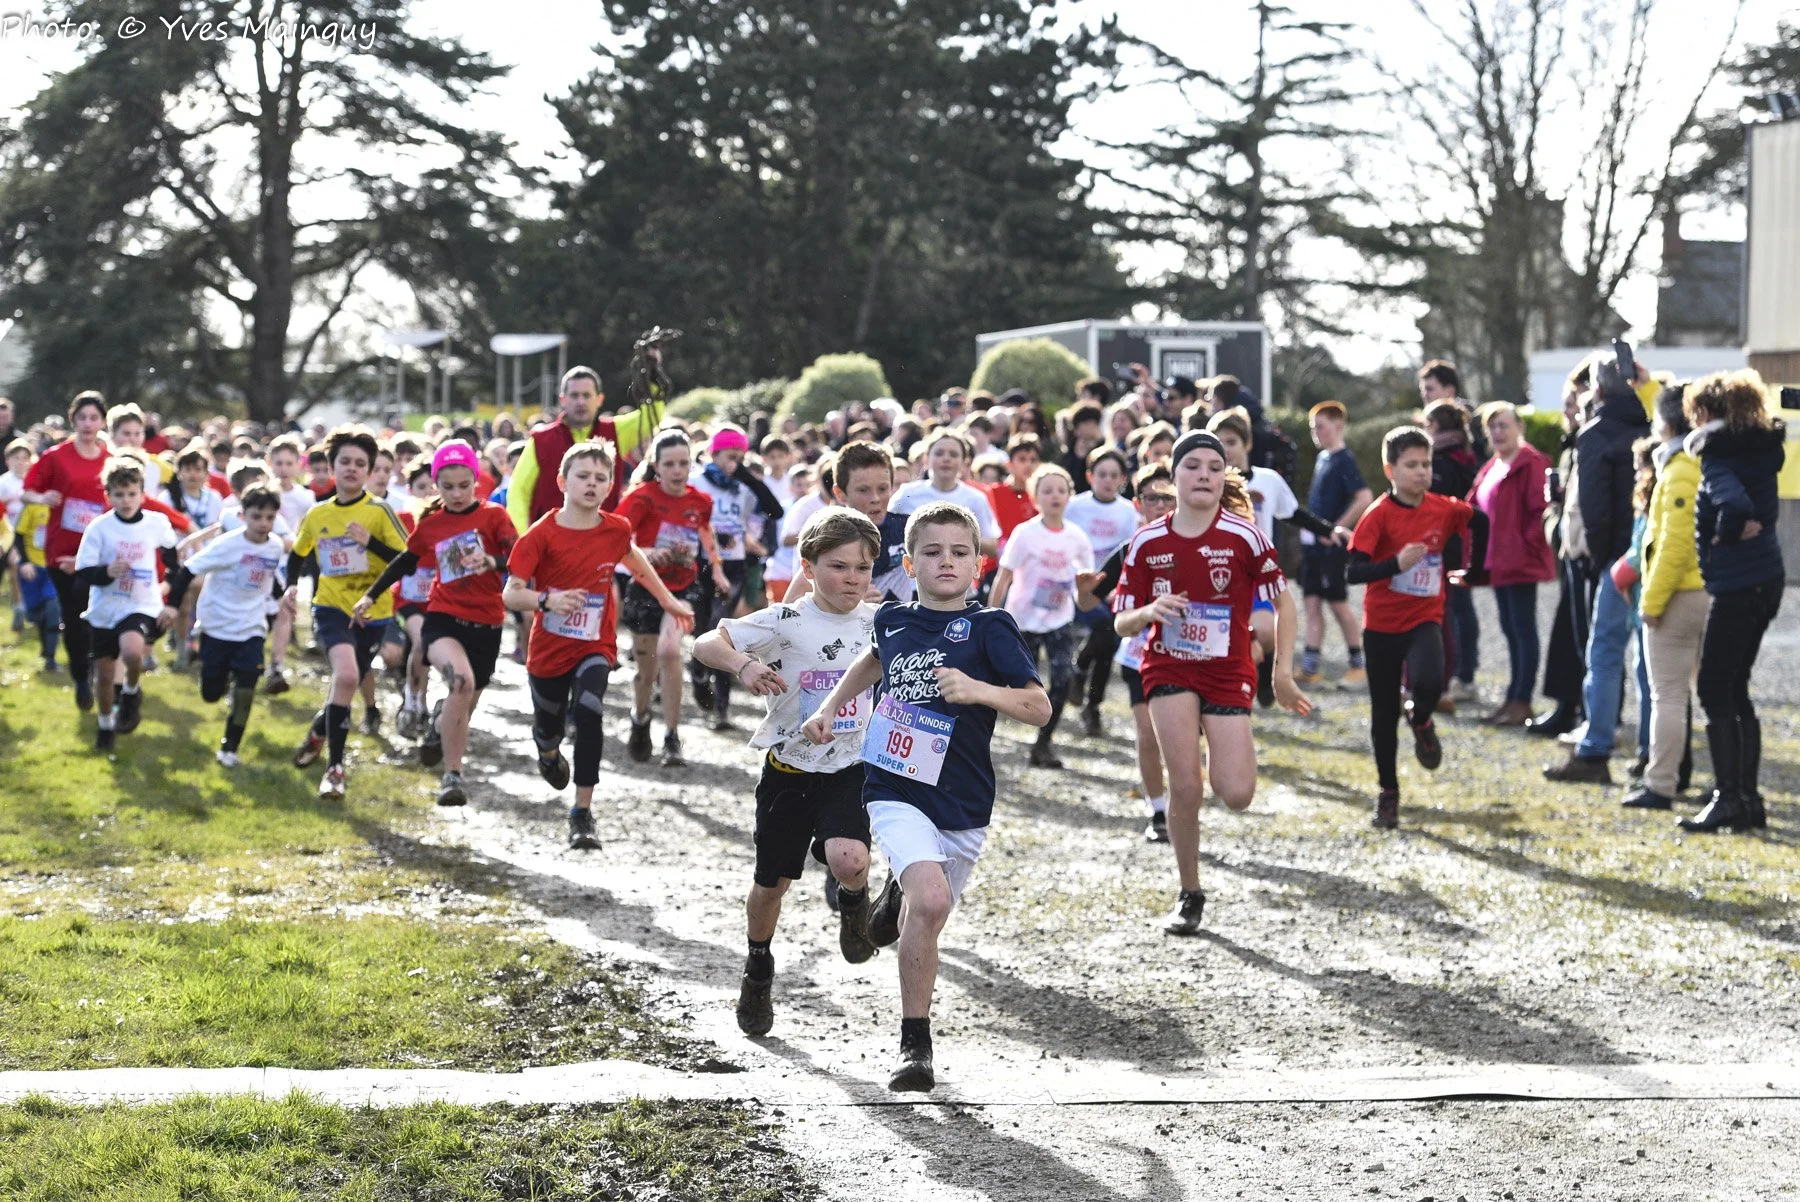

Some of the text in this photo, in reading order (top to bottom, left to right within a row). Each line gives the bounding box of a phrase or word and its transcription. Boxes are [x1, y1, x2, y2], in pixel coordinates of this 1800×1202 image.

[563, 612, 588, 628] 201
[1180, 622, 1207, 643] 388
[889, 648, 947, 675] LA COUPE
[889, 674, 900, 686] DE
[900, 670, 923, 683] TOUS
[832, 720, 855, 729] UPER
[882, 704, 951, 732] GLAZIG KINDER
[886, 729, 914, 759] 199
[876, 753, 905, 771] SUPER
